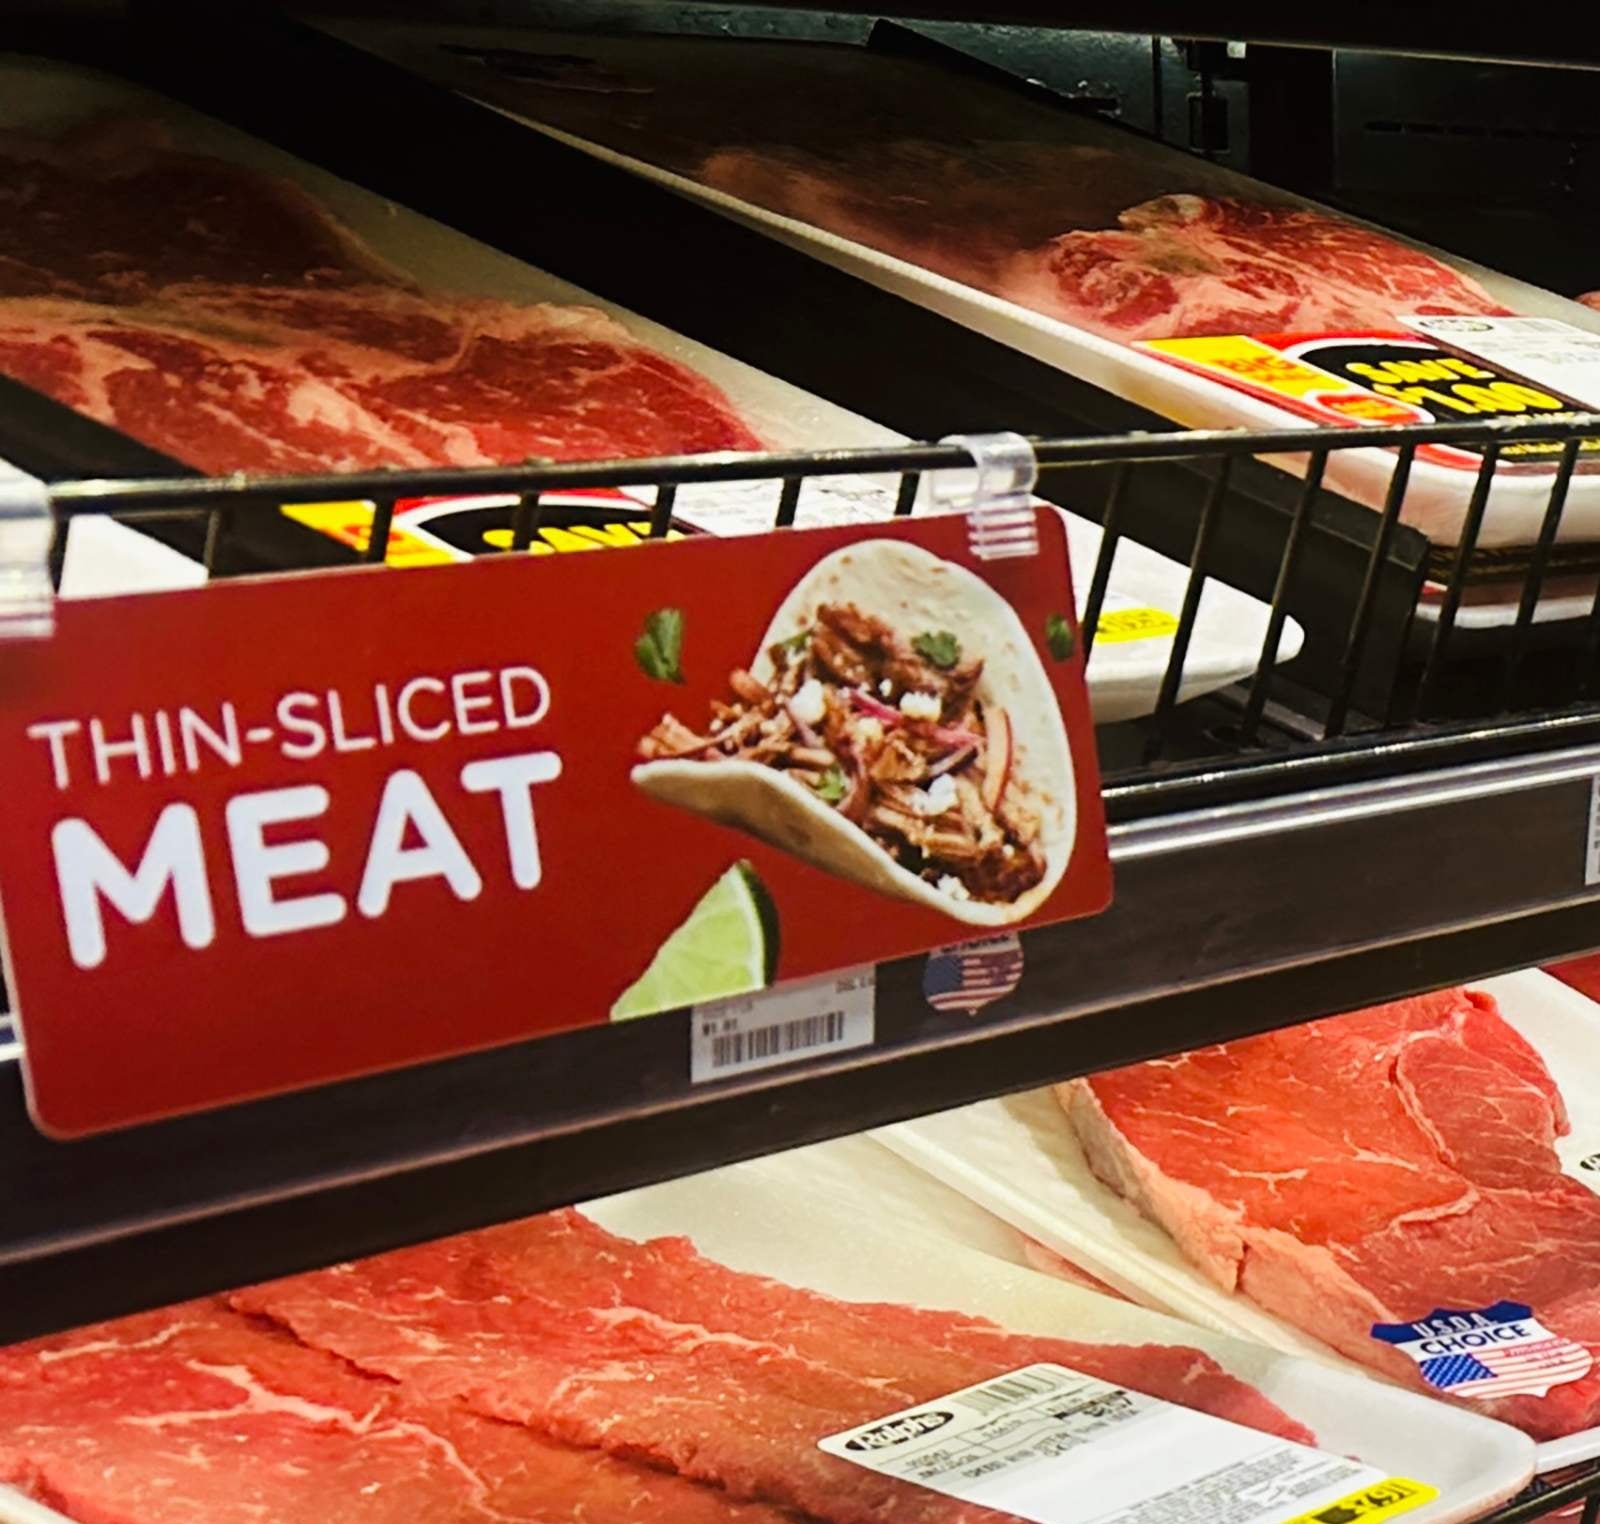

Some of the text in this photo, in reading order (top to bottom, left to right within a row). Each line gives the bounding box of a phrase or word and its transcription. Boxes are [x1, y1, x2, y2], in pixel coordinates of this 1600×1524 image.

[1345, 358, 1496, 385] SAVE
[28, 665, 551, 790] THIN-SLICED
[49, 750, 563, 970] MEAT
[1419, 1323, 1532, 1357] CHOICE
[852, 1411, 946, 1451] Ralphs
